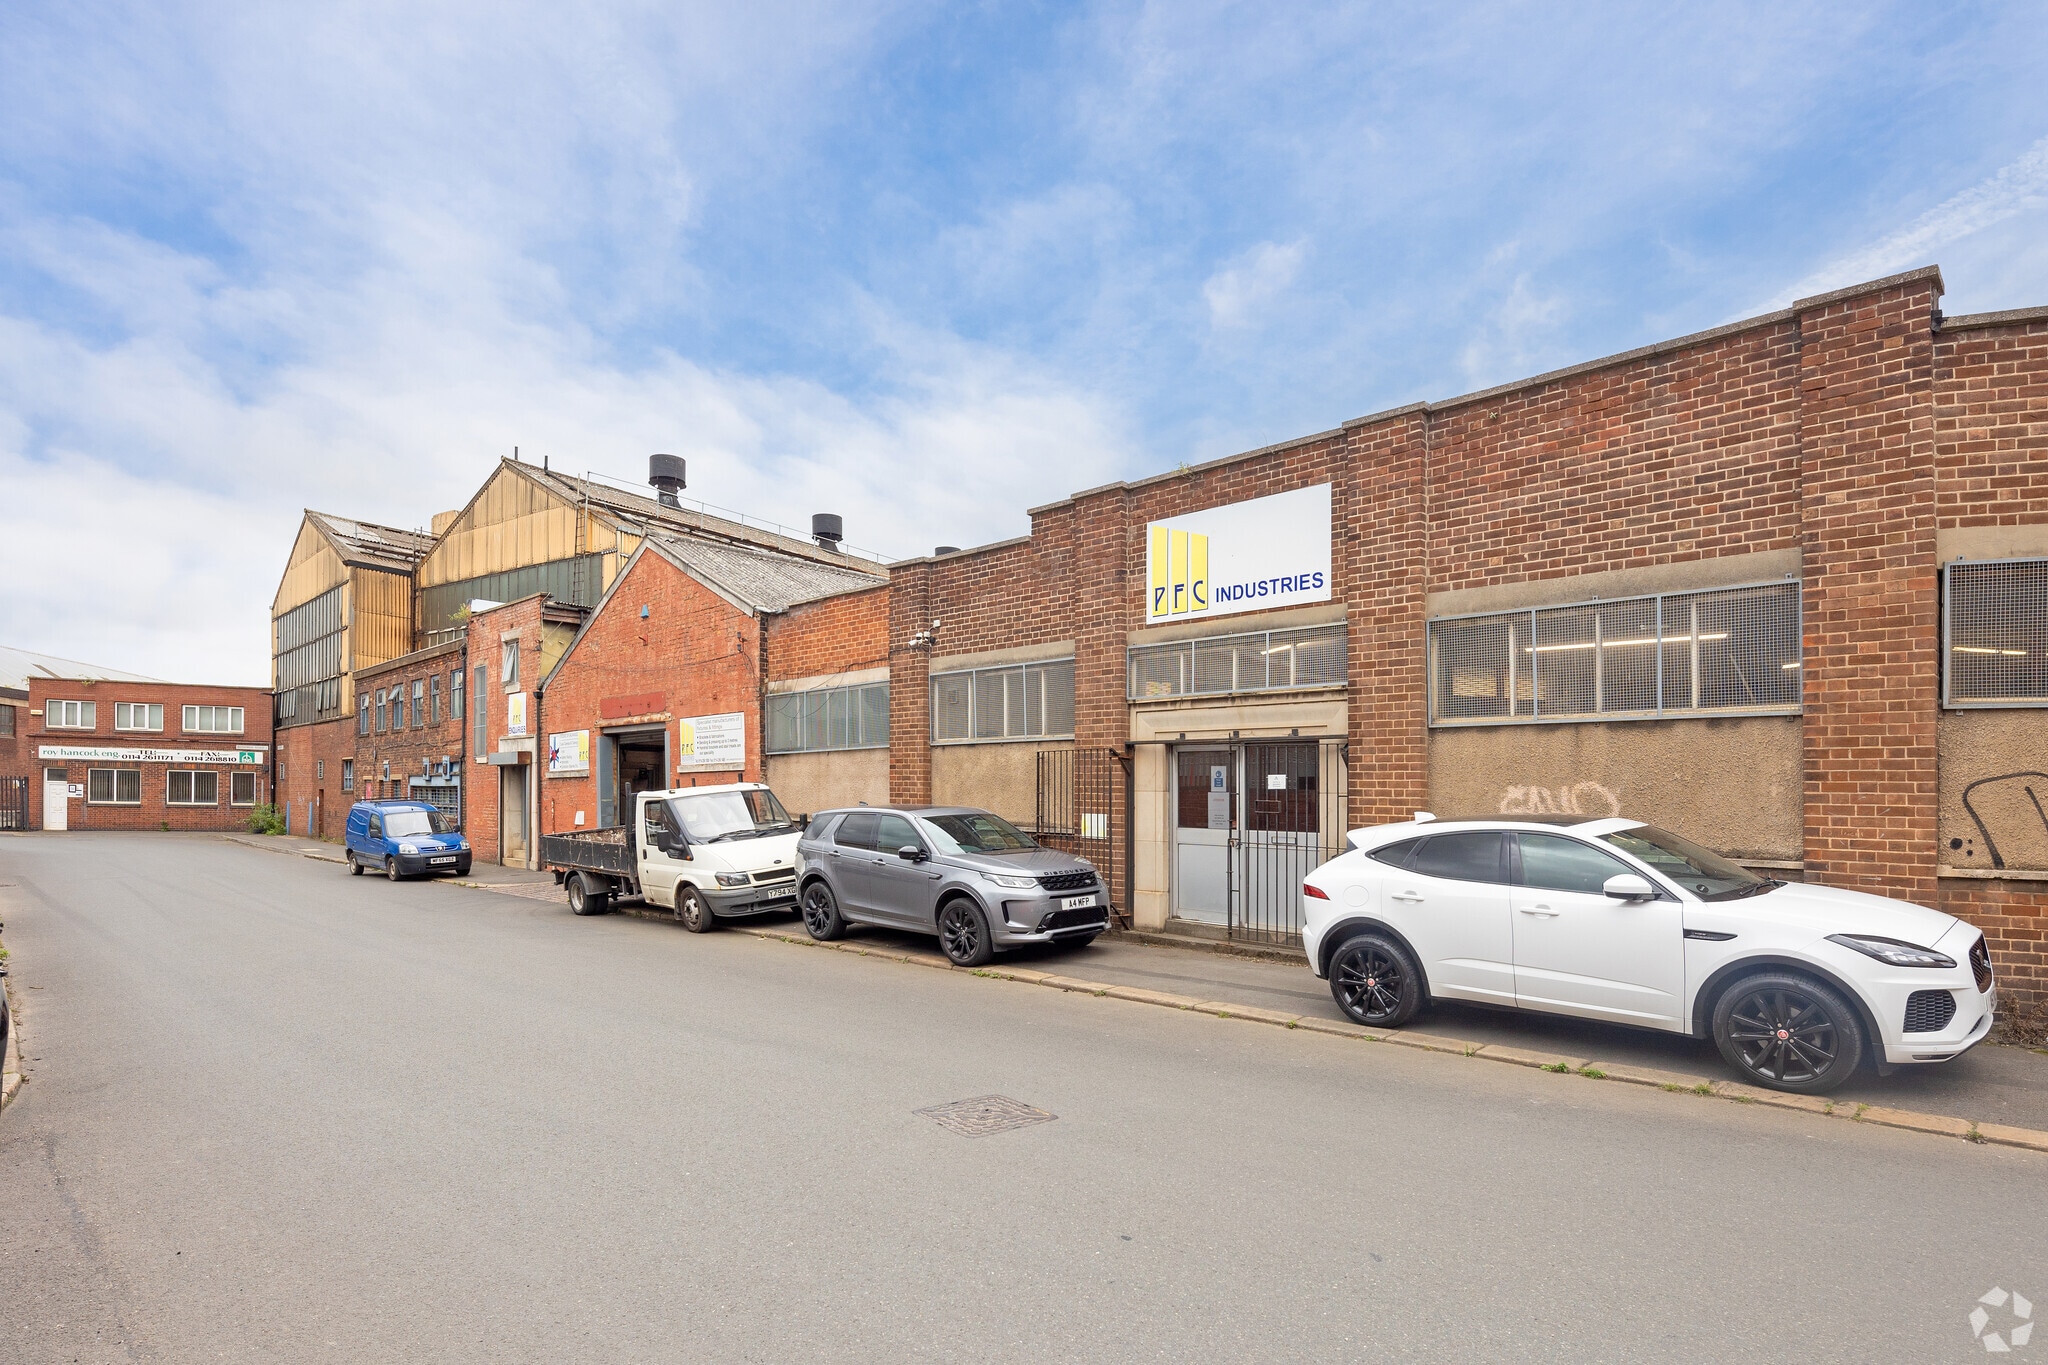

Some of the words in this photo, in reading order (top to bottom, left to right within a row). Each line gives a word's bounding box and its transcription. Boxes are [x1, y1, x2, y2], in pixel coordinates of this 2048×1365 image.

[1215, 571, 1324, 603] INDUSTRIES
[42, 748, 58, 757] roy
[60, 748, 100, 757] hancock
[1043, 868, 1088, 876] DISCOVERY
[1069, 898, 1077, 908] A4
